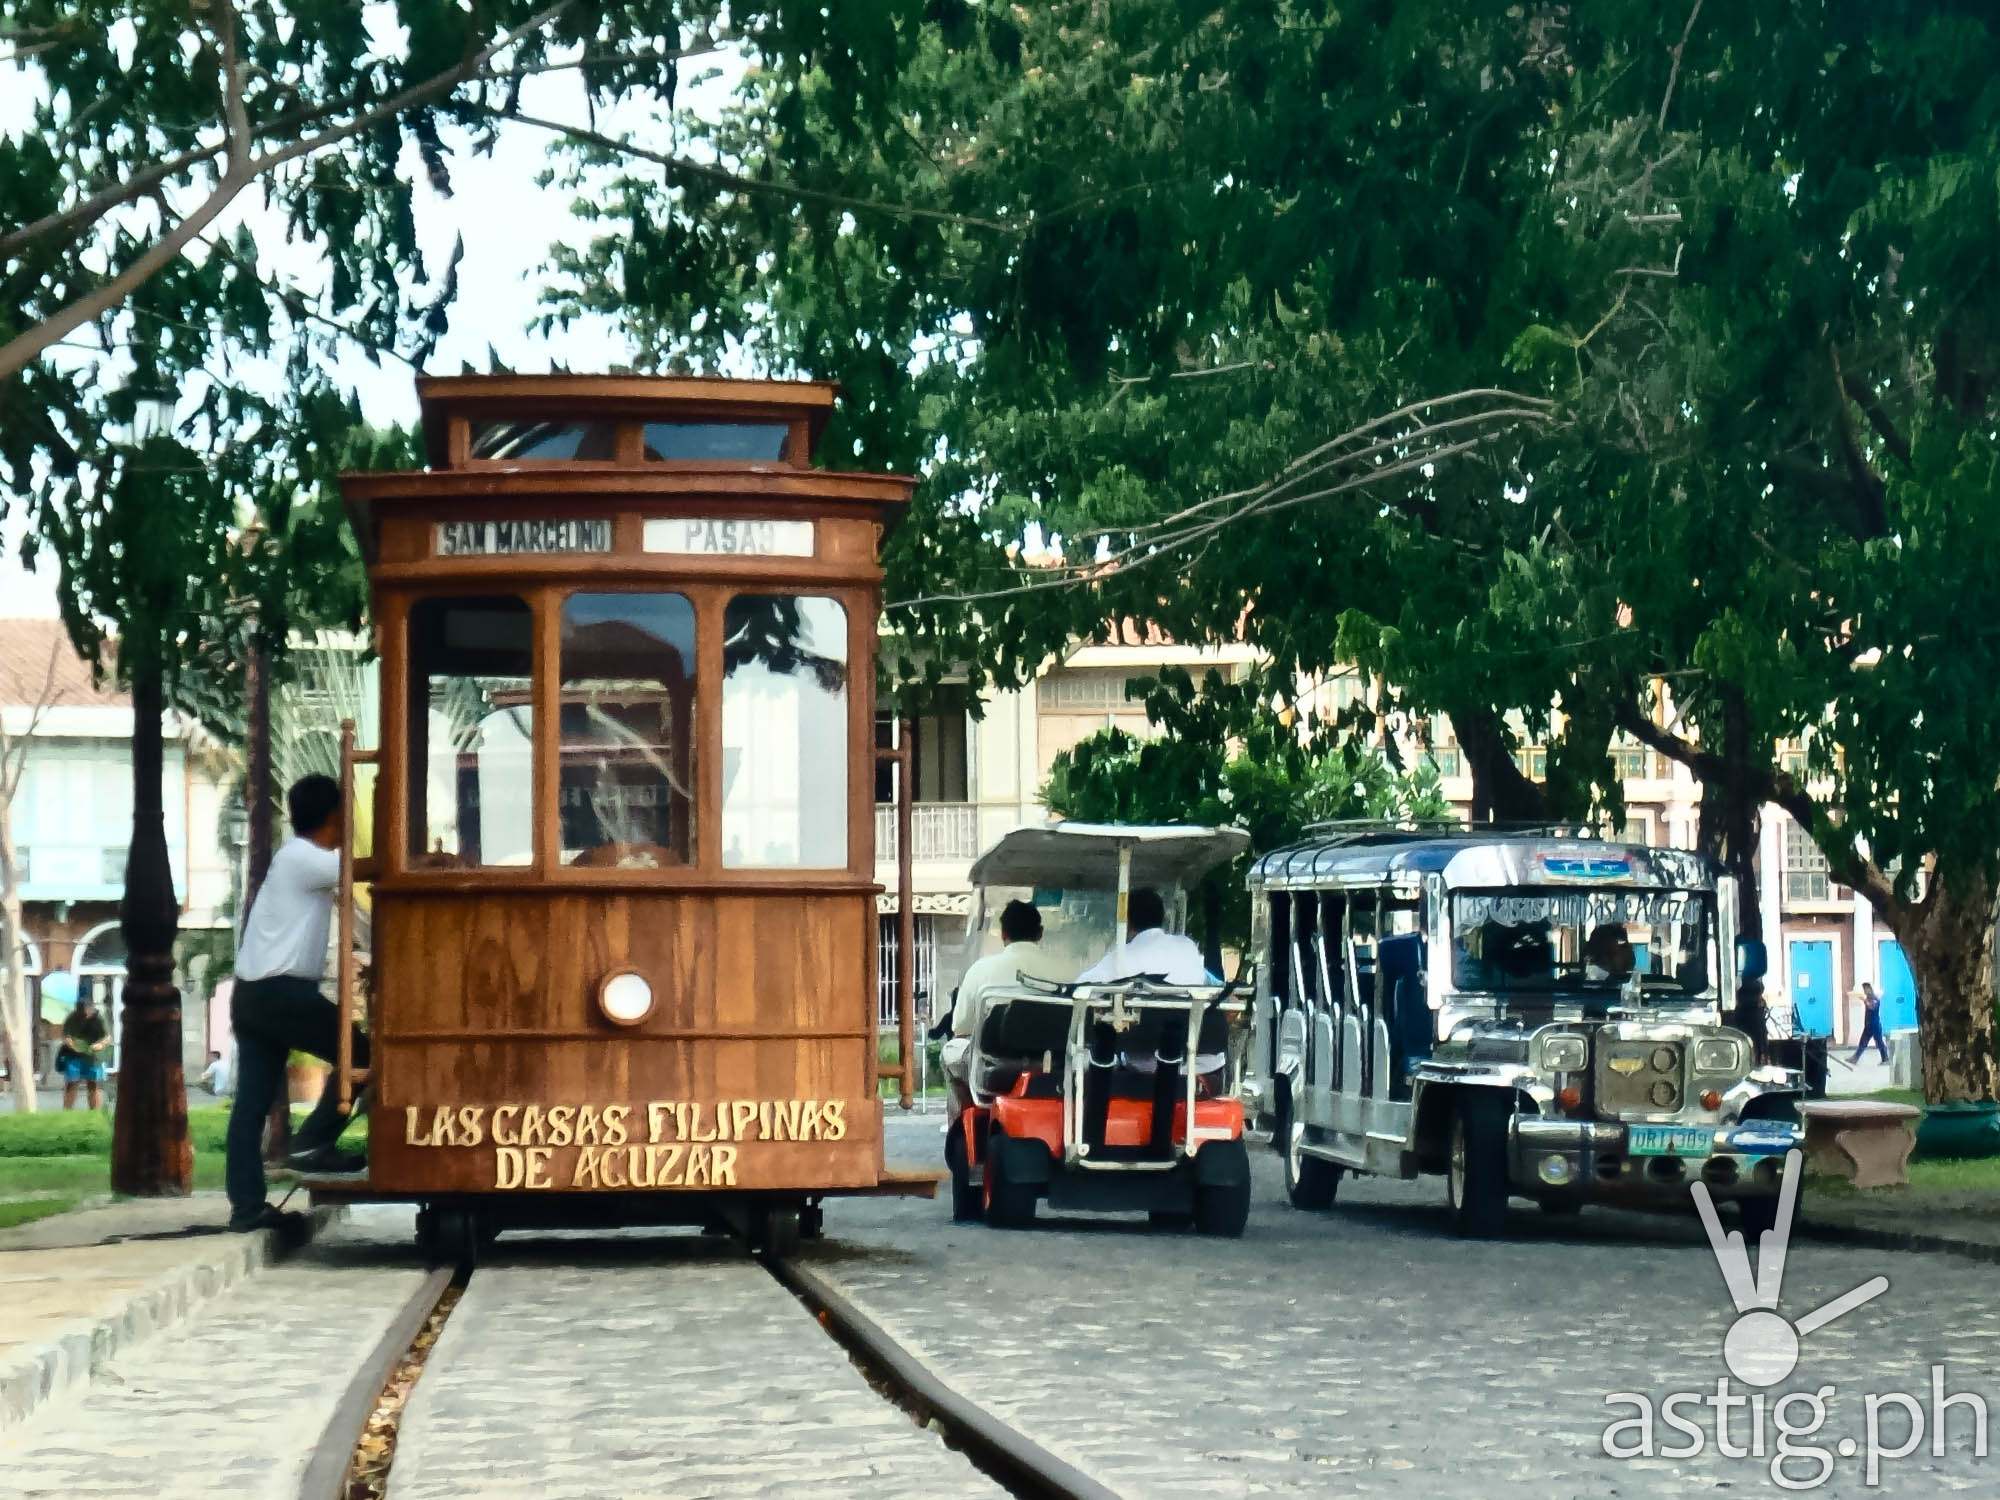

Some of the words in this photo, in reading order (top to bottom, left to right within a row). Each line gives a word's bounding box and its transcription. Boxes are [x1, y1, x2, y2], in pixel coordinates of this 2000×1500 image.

[442, 520, 487, 554] SAN
[405, 1104, 486, 1147] LAS
[490, 1103, 632, 1147] CASAS
[646, 1099, 847, 1144] FILIPINAS
[494, 1146, 553, 1189] DE
[571, 1145, 738, 1188] ACUZAR
